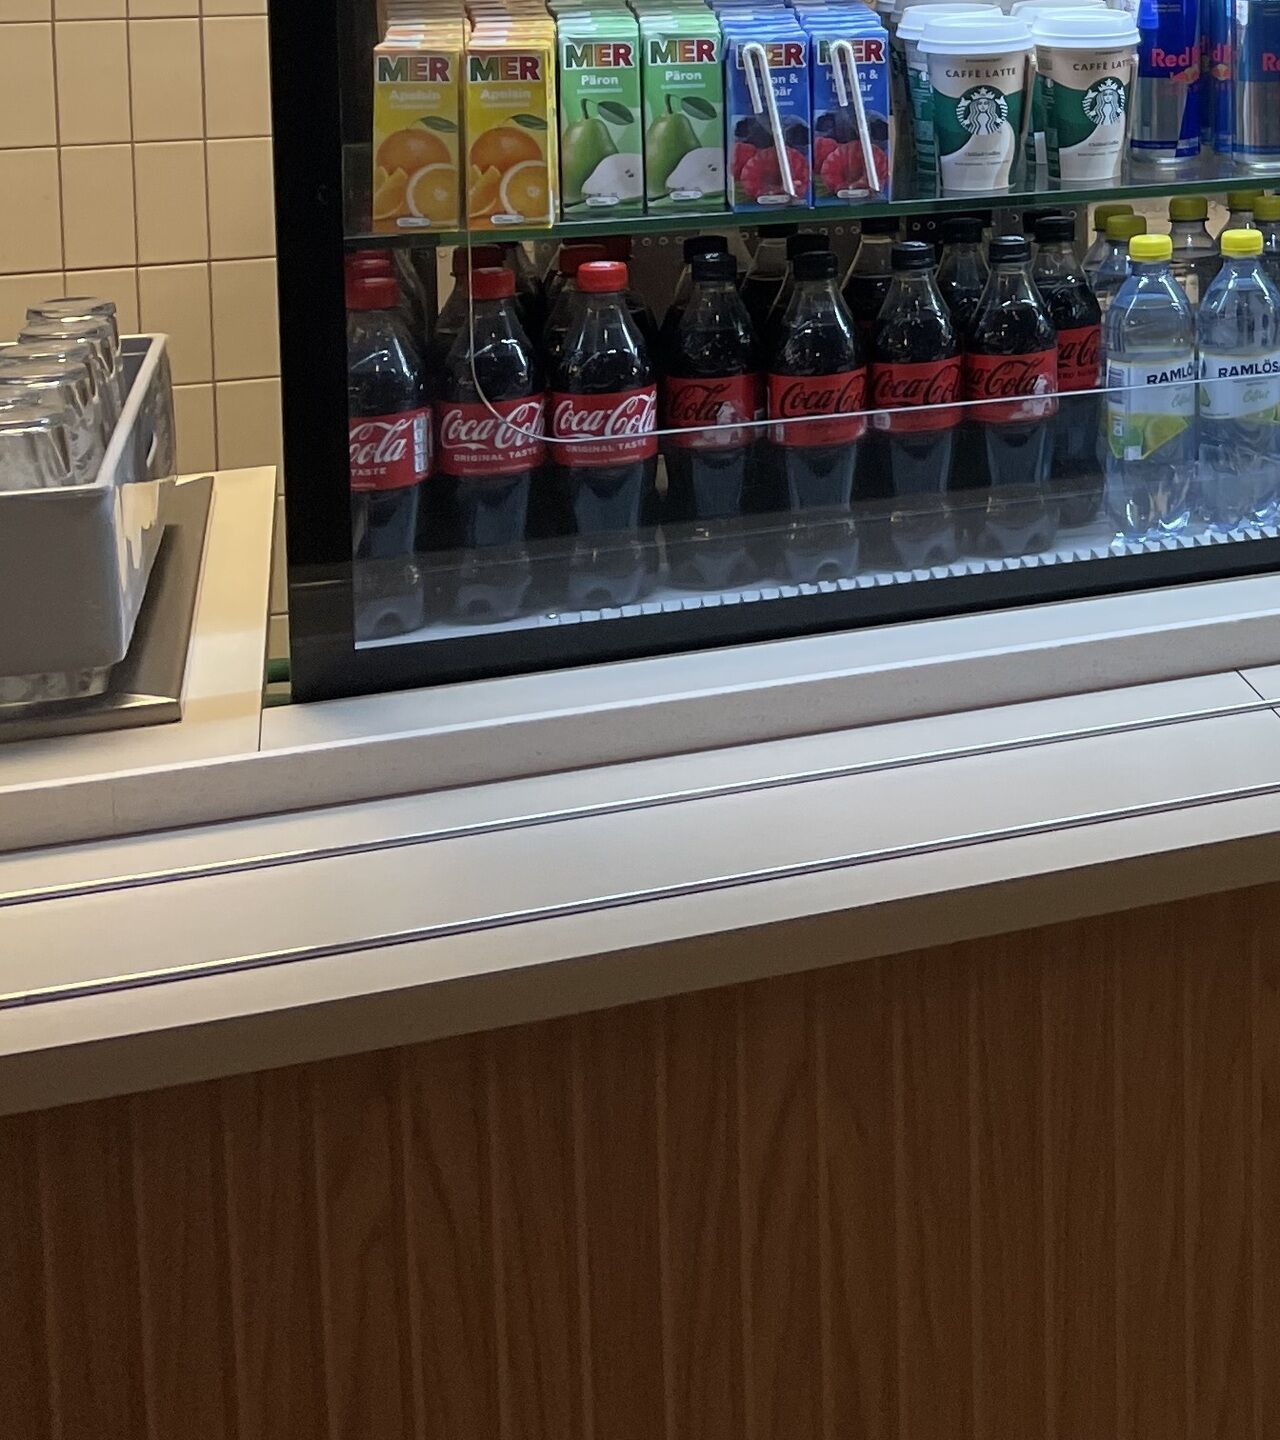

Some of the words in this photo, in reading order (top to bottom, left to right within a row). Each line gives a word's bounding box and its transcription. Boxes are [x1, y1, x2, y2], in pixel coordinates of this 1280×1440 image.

[565, 43, 633, 67] MER
[650, 39, 717, 64] MER
[1152, 46, 1190, 67] Red
[378, 57, 450, 82] MER
[470, 56, 541, 81] MER
[665, 70, 702, 81] Päron
[985, 67, 1017, 78] LATTE
[581, 74, 619, 86] Päron
[618, 438, 648, 449] TASTE
[454, 453, 503, 462] ORIGINAL
[509, 446, 537, 458] TASTE
